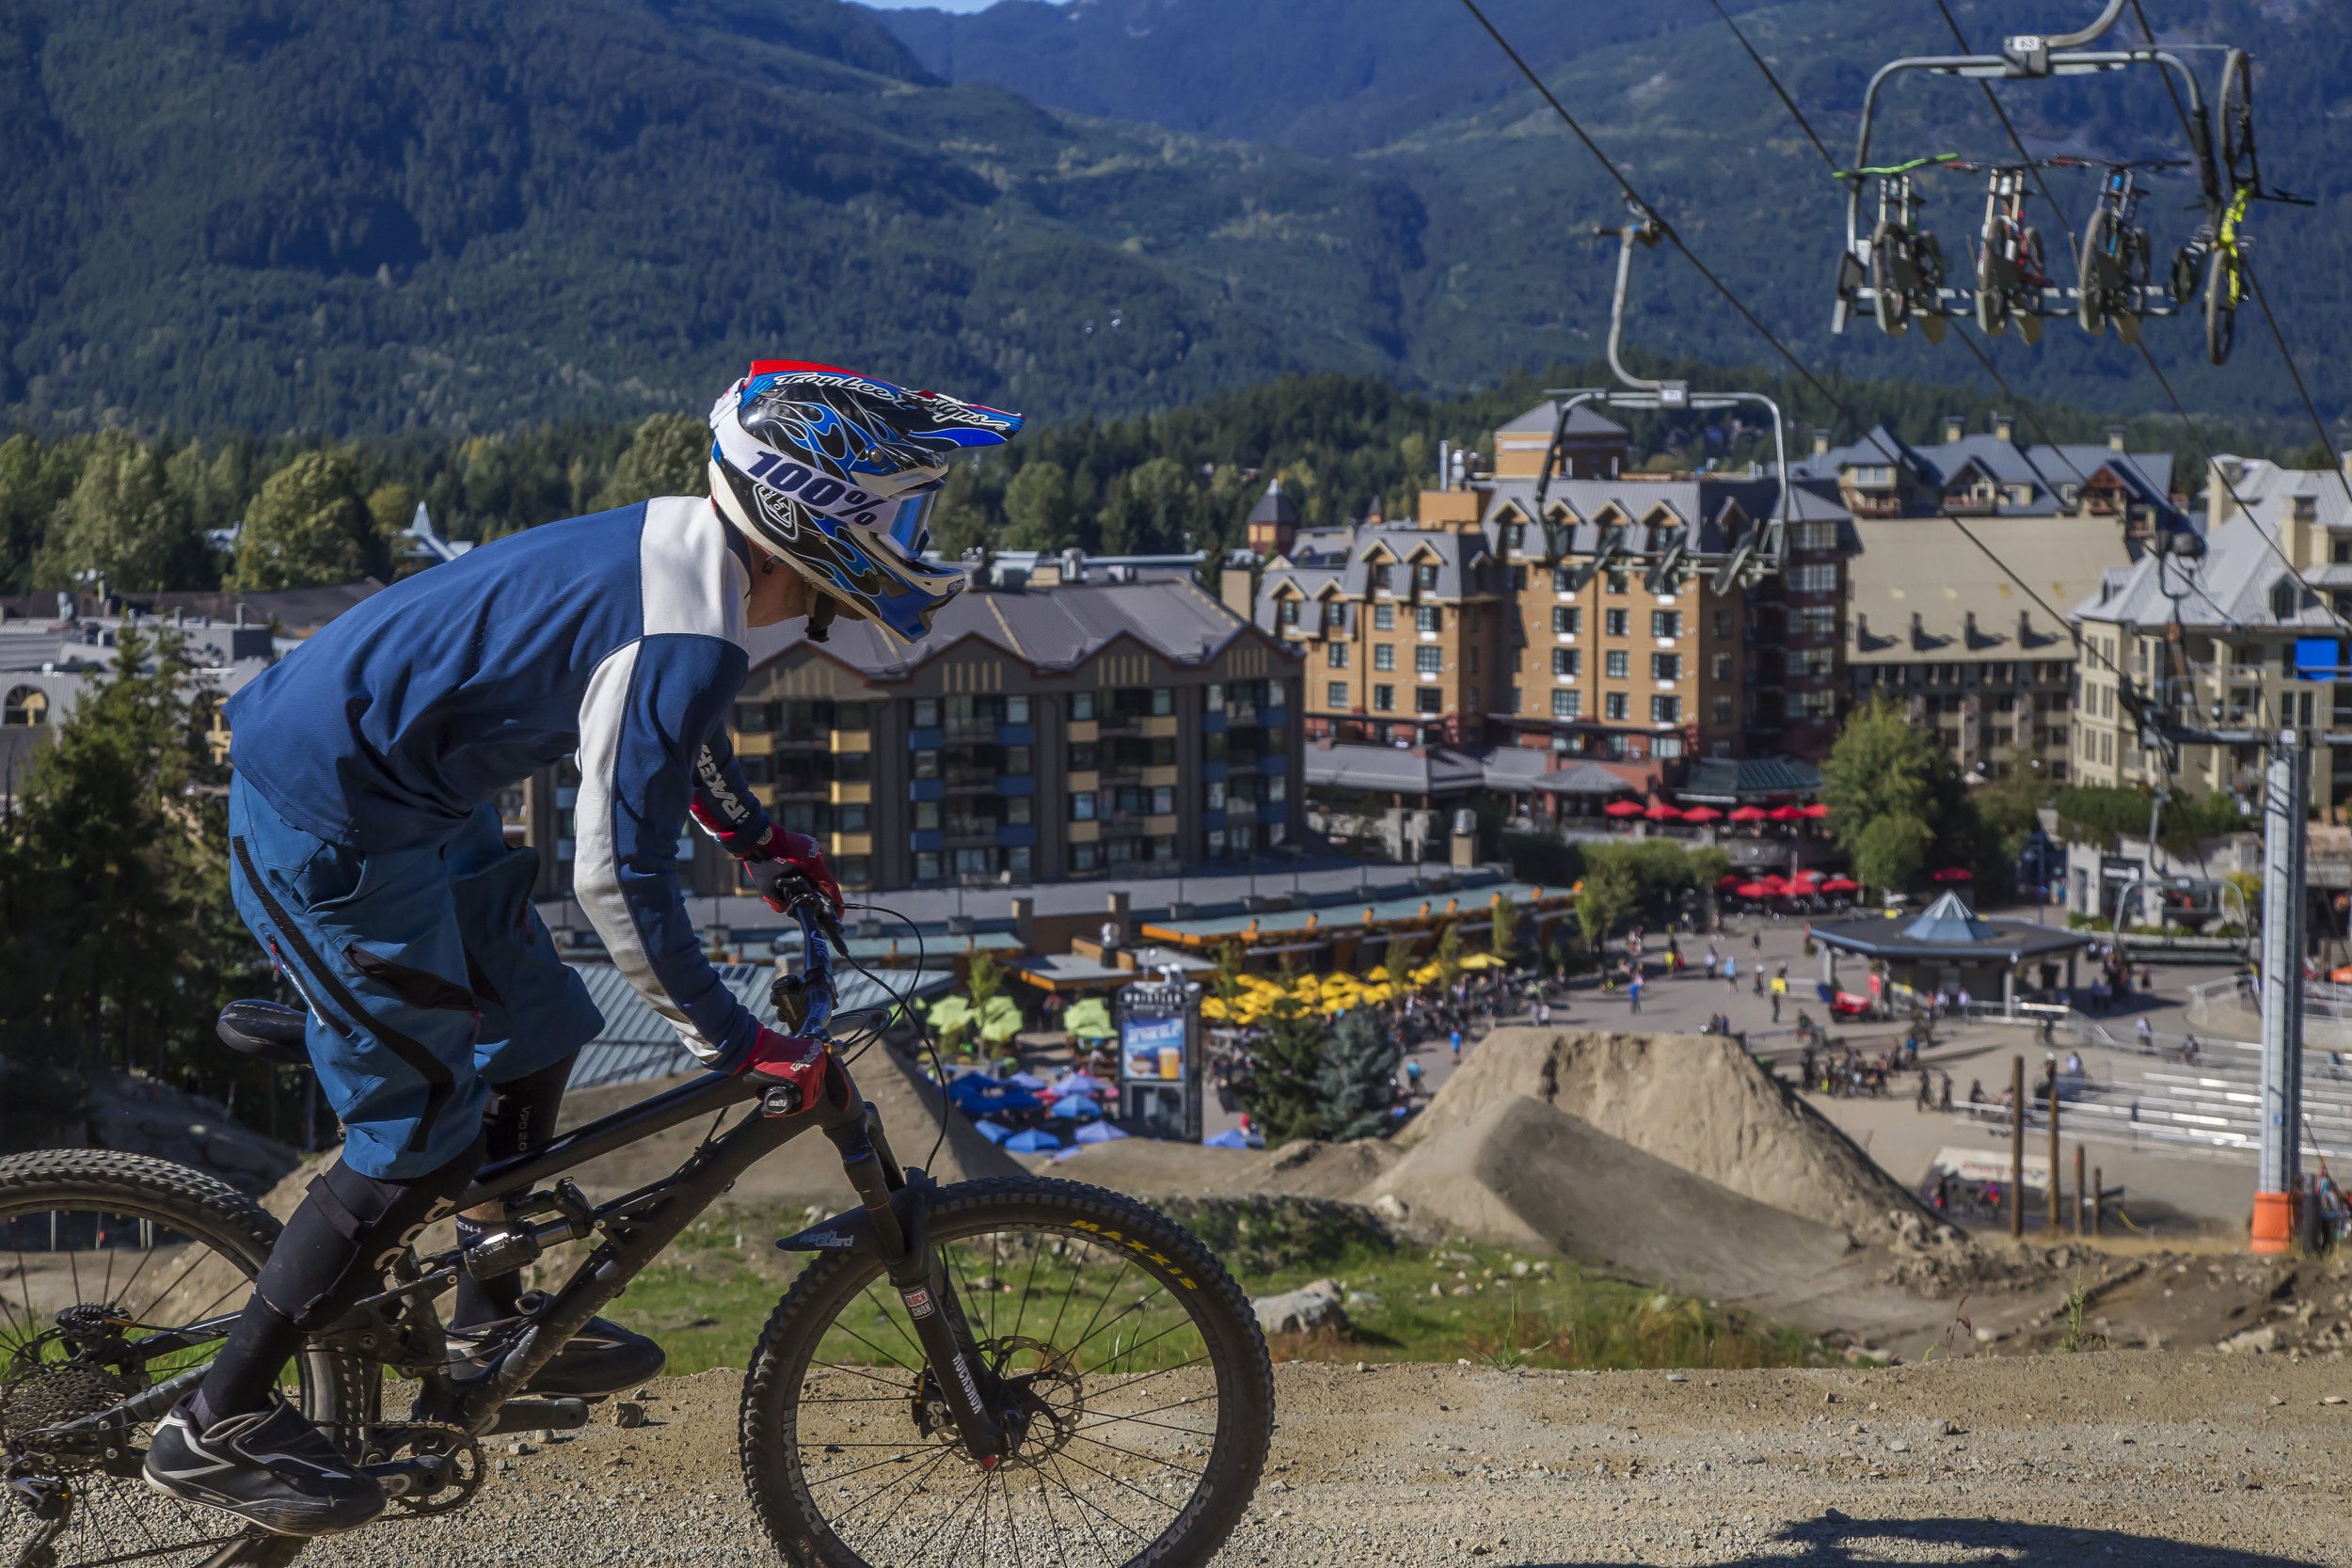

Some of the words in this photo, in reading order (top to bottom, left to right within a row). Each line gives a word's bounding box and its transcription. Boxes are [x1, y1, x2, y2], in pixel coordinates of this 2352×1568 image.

[748, 450, 888, 526] 100%
[1069, 1220, 1198, 1291] MAXXIS
[906, 1291, 928, 1307] ROCK
[782, 1420, 827, 1535] RACEFACE
